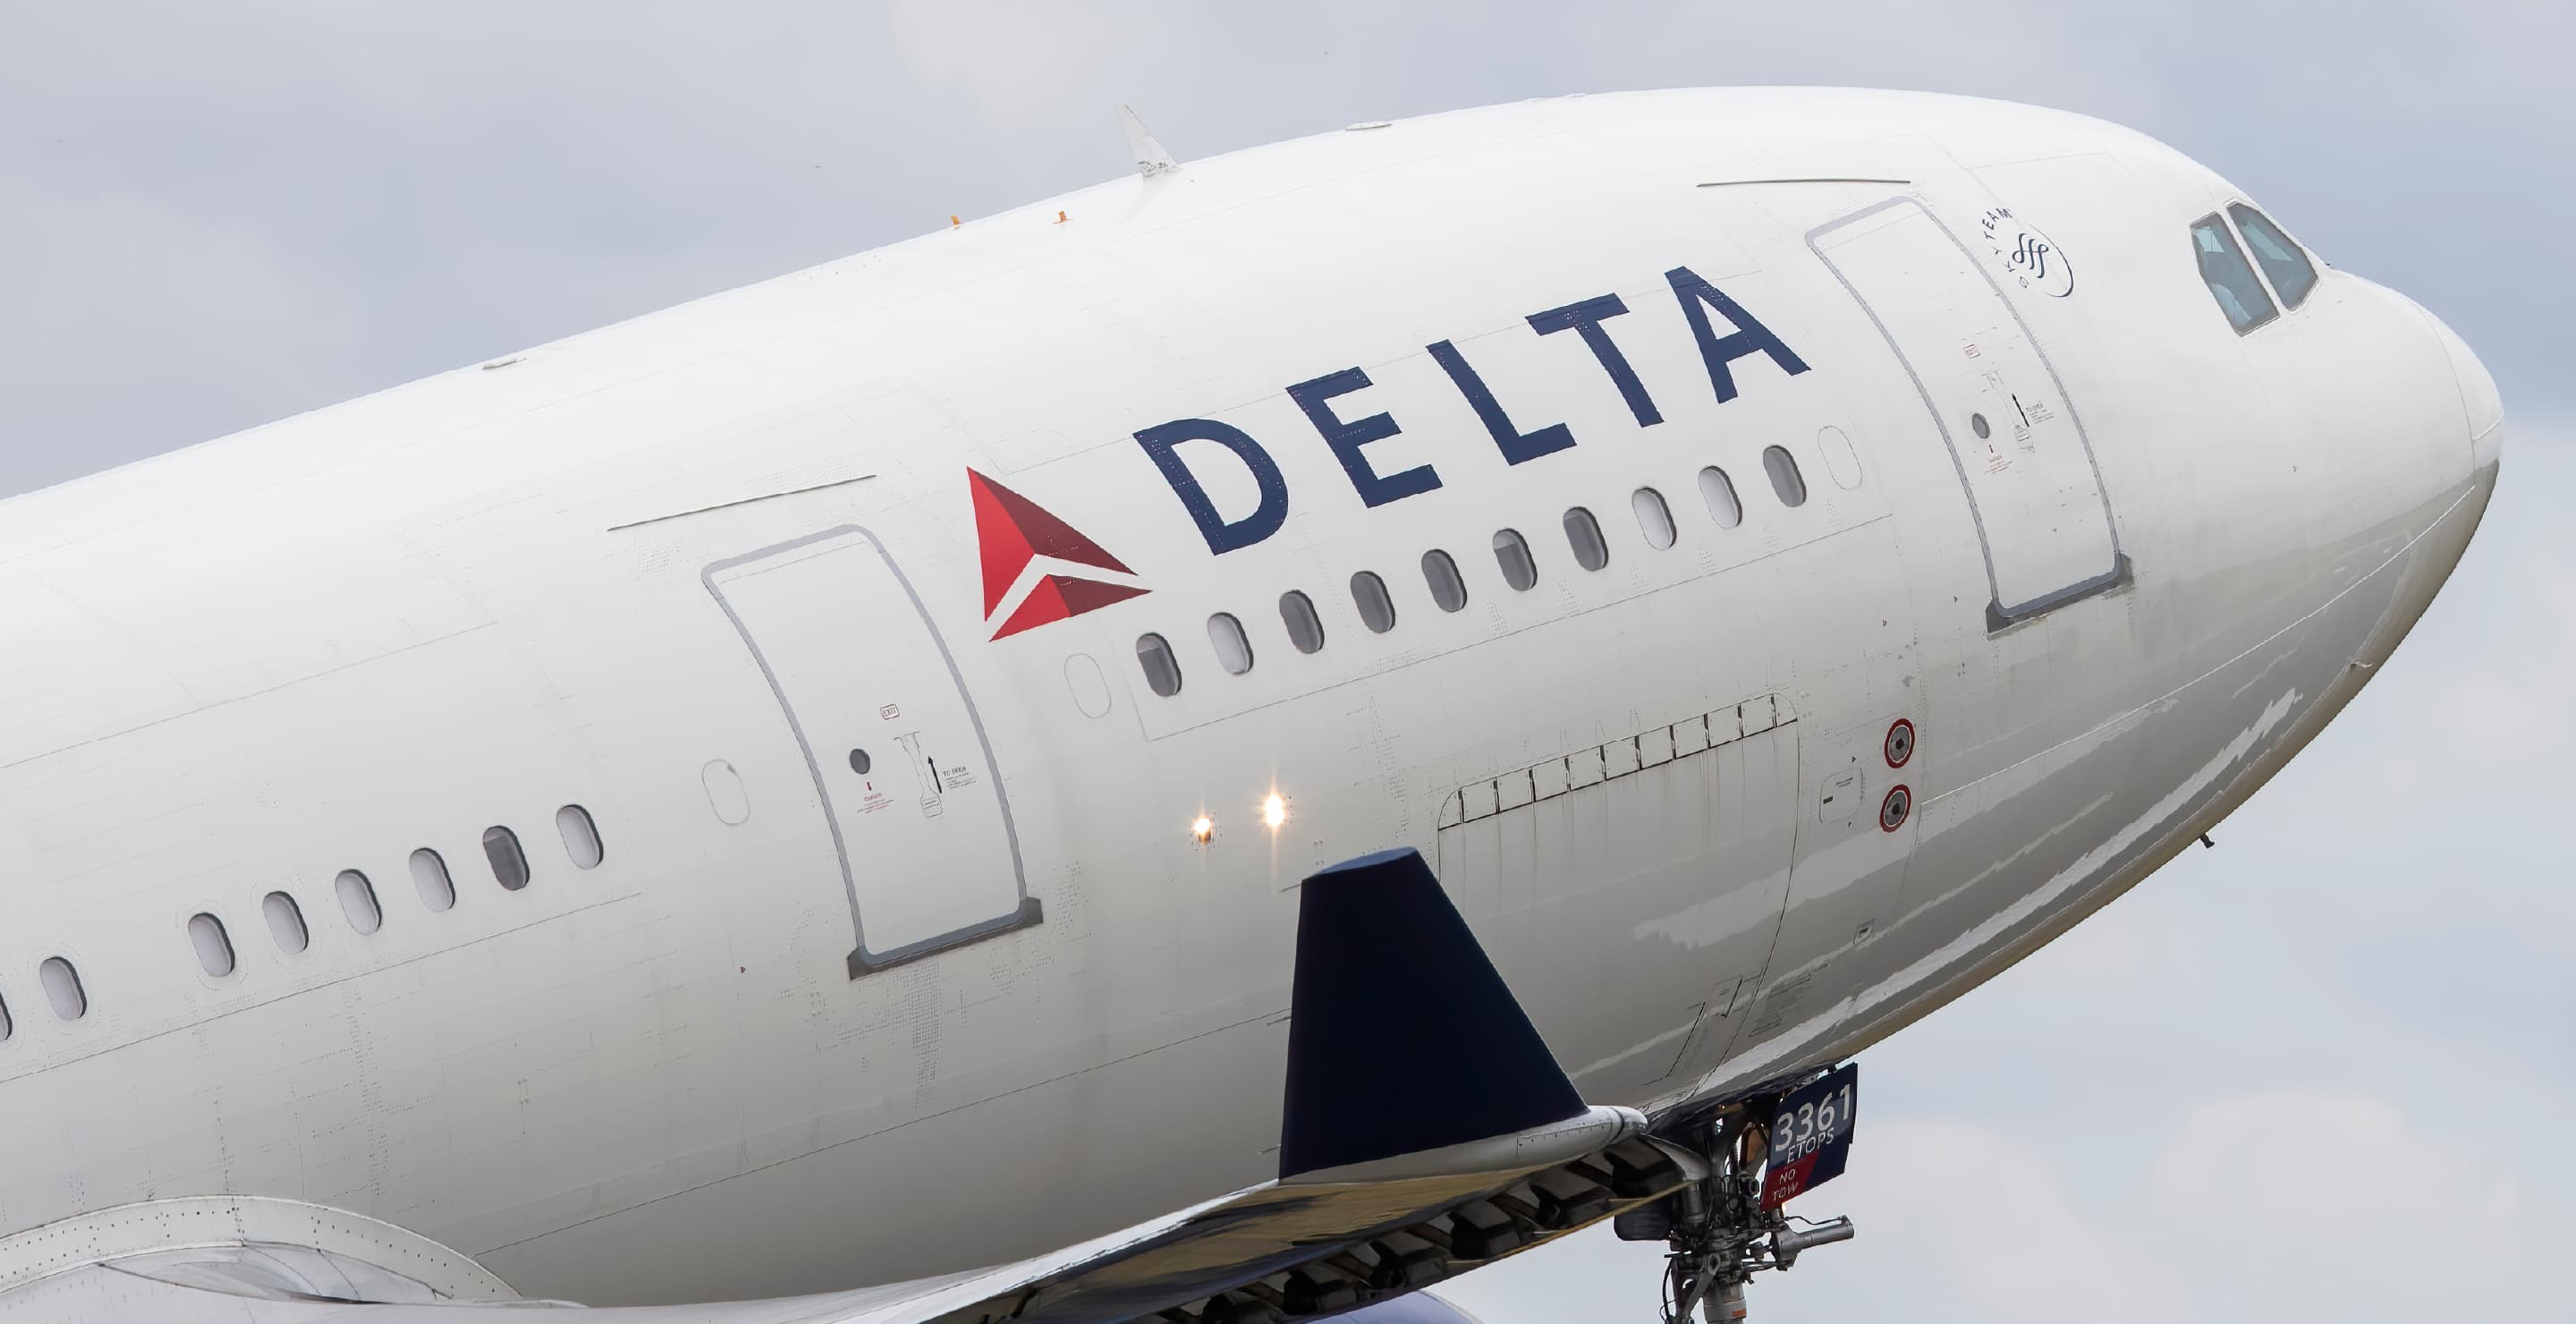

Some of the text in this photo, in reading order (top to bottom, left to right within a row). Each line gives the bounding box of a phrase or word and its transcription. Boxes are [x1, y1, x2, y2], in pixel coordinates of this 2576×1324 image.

[1133, 267, 1809, 555] DELTA
[1775, 1084, 1852, 1152] 3361
[1787, 1127, 1835, 1164] ETOPS
[1774, 1183, 1799, 1201] TOW
[1779, 1168, 1796, 1184] NO
